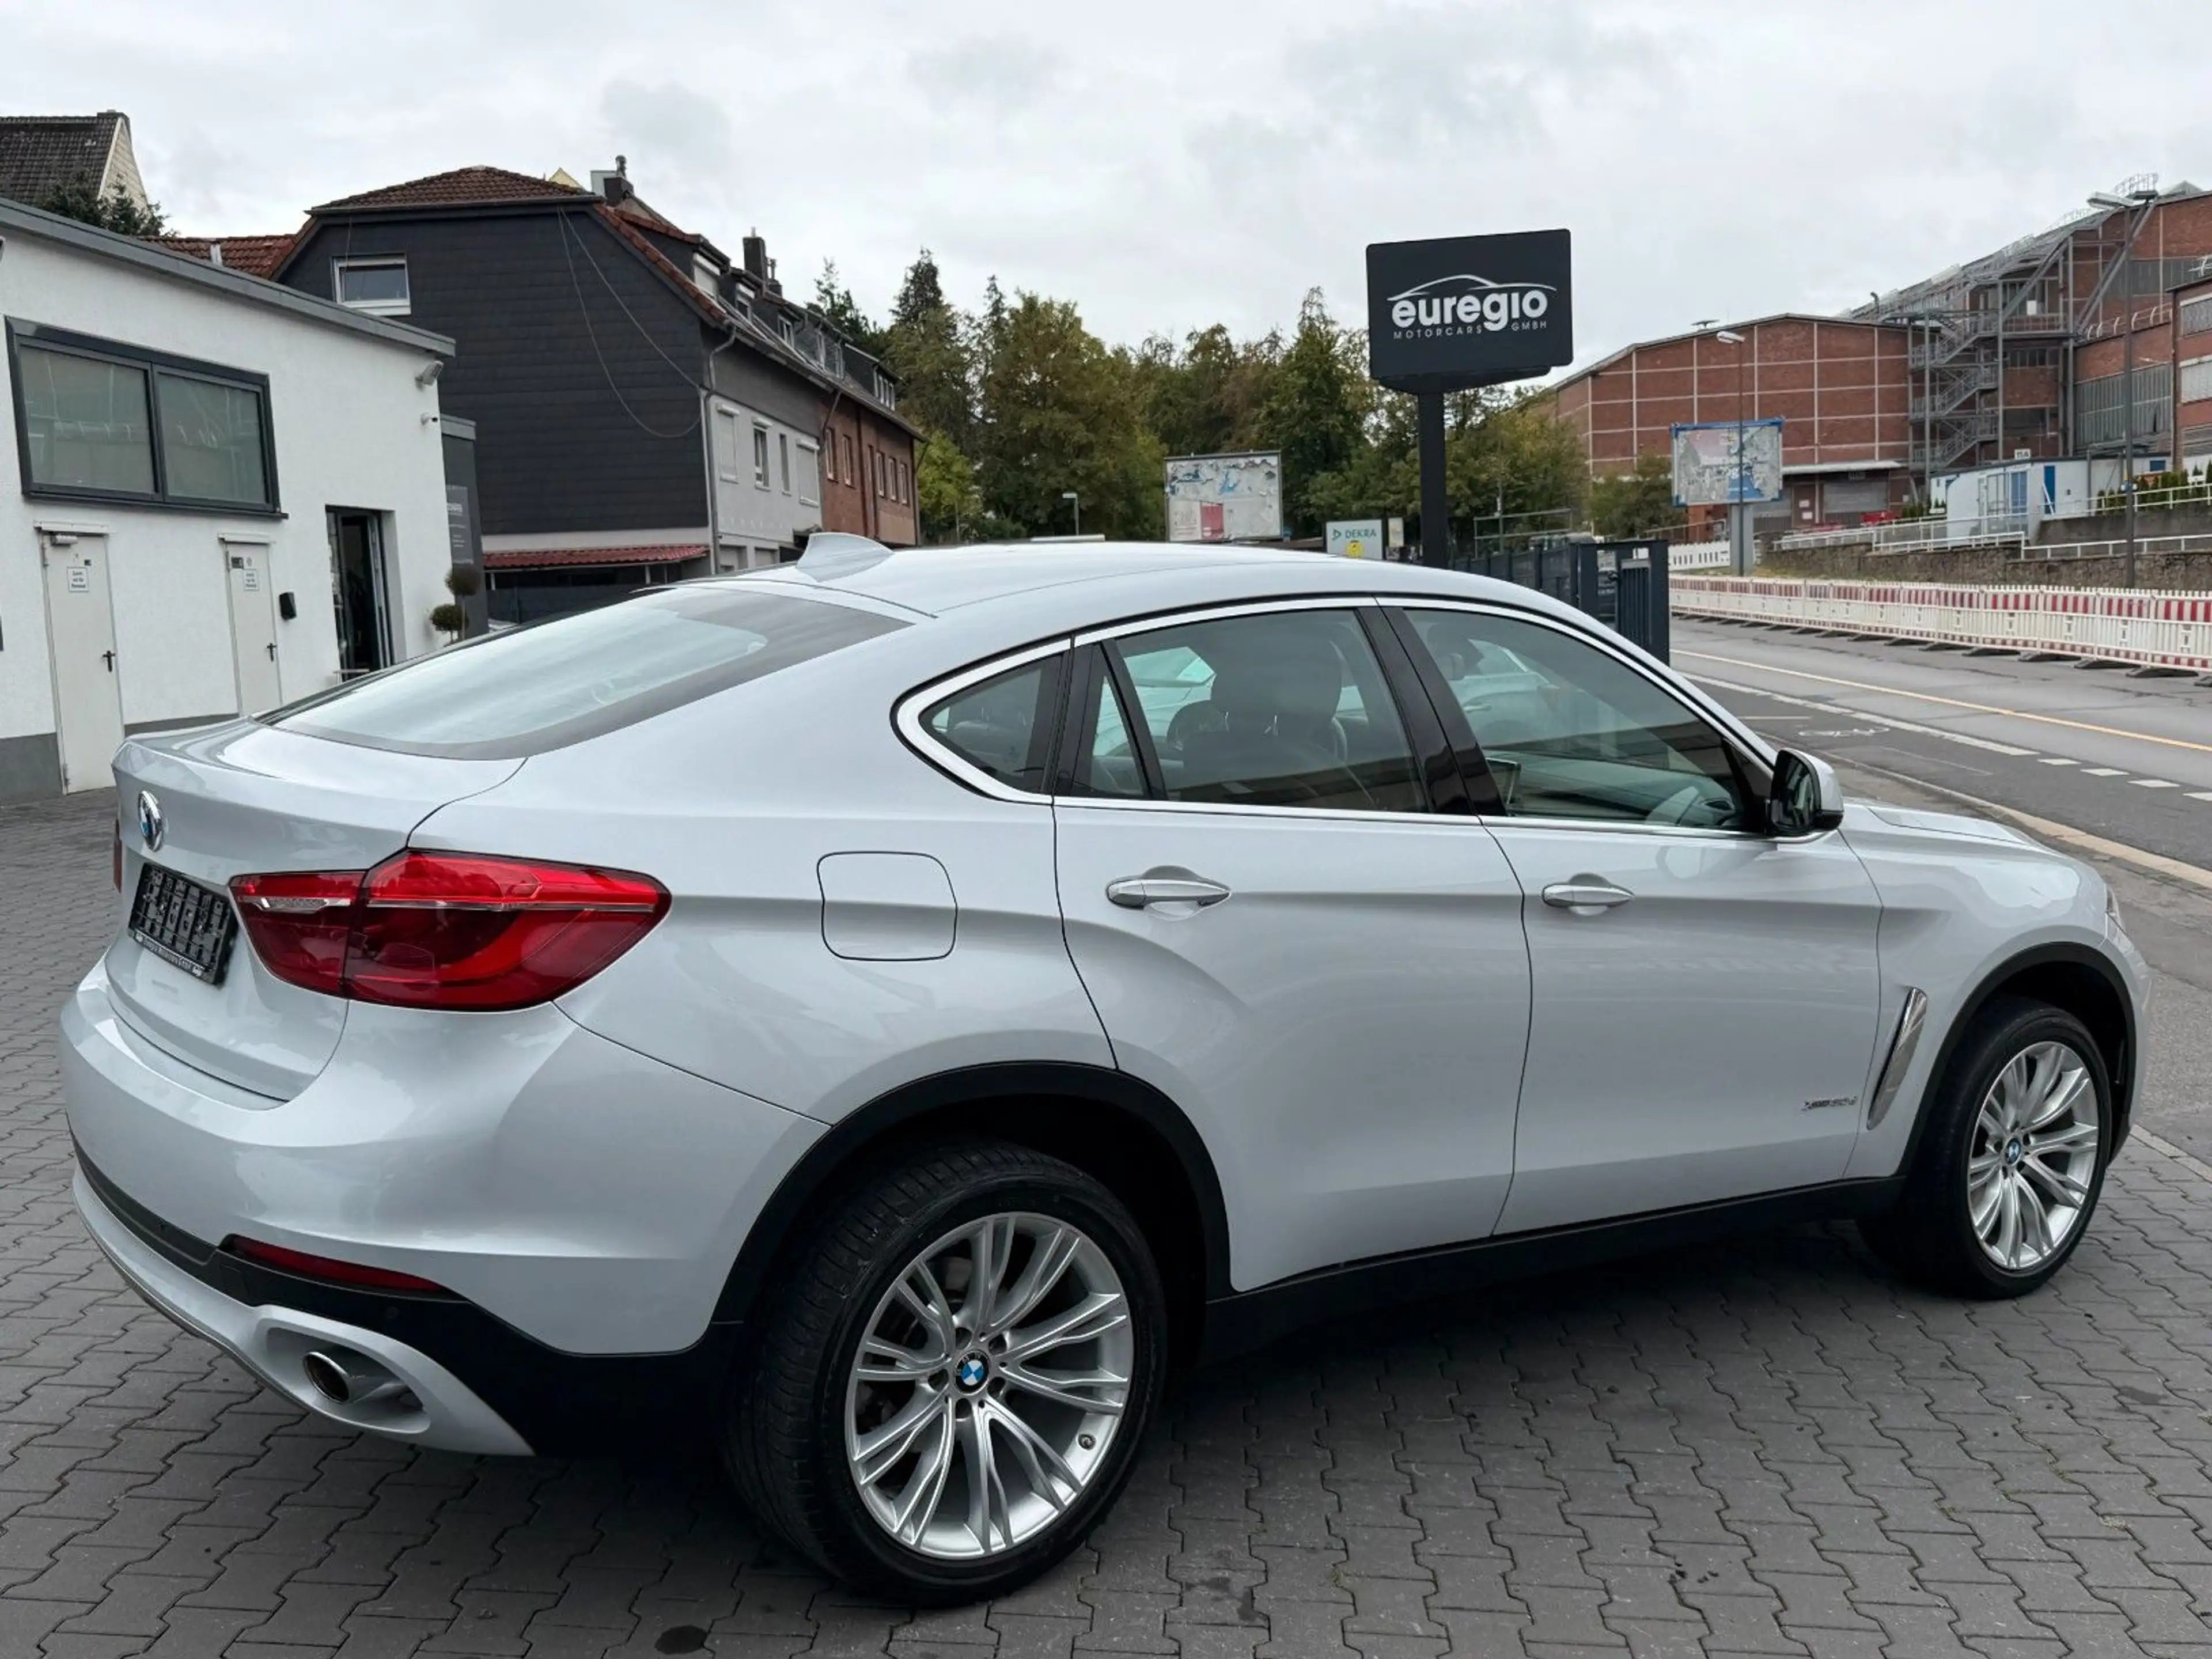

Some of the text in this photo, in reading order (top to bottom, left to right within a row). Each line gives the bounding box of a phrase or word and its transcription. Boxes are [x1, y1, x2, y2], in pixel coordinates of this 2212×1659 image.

[1392, 290, 1548, 331] euregio
[1393, 320, 1547, 340] MOTORCARS GMBH
[1345, 528, 1377, 539] DEKRA
